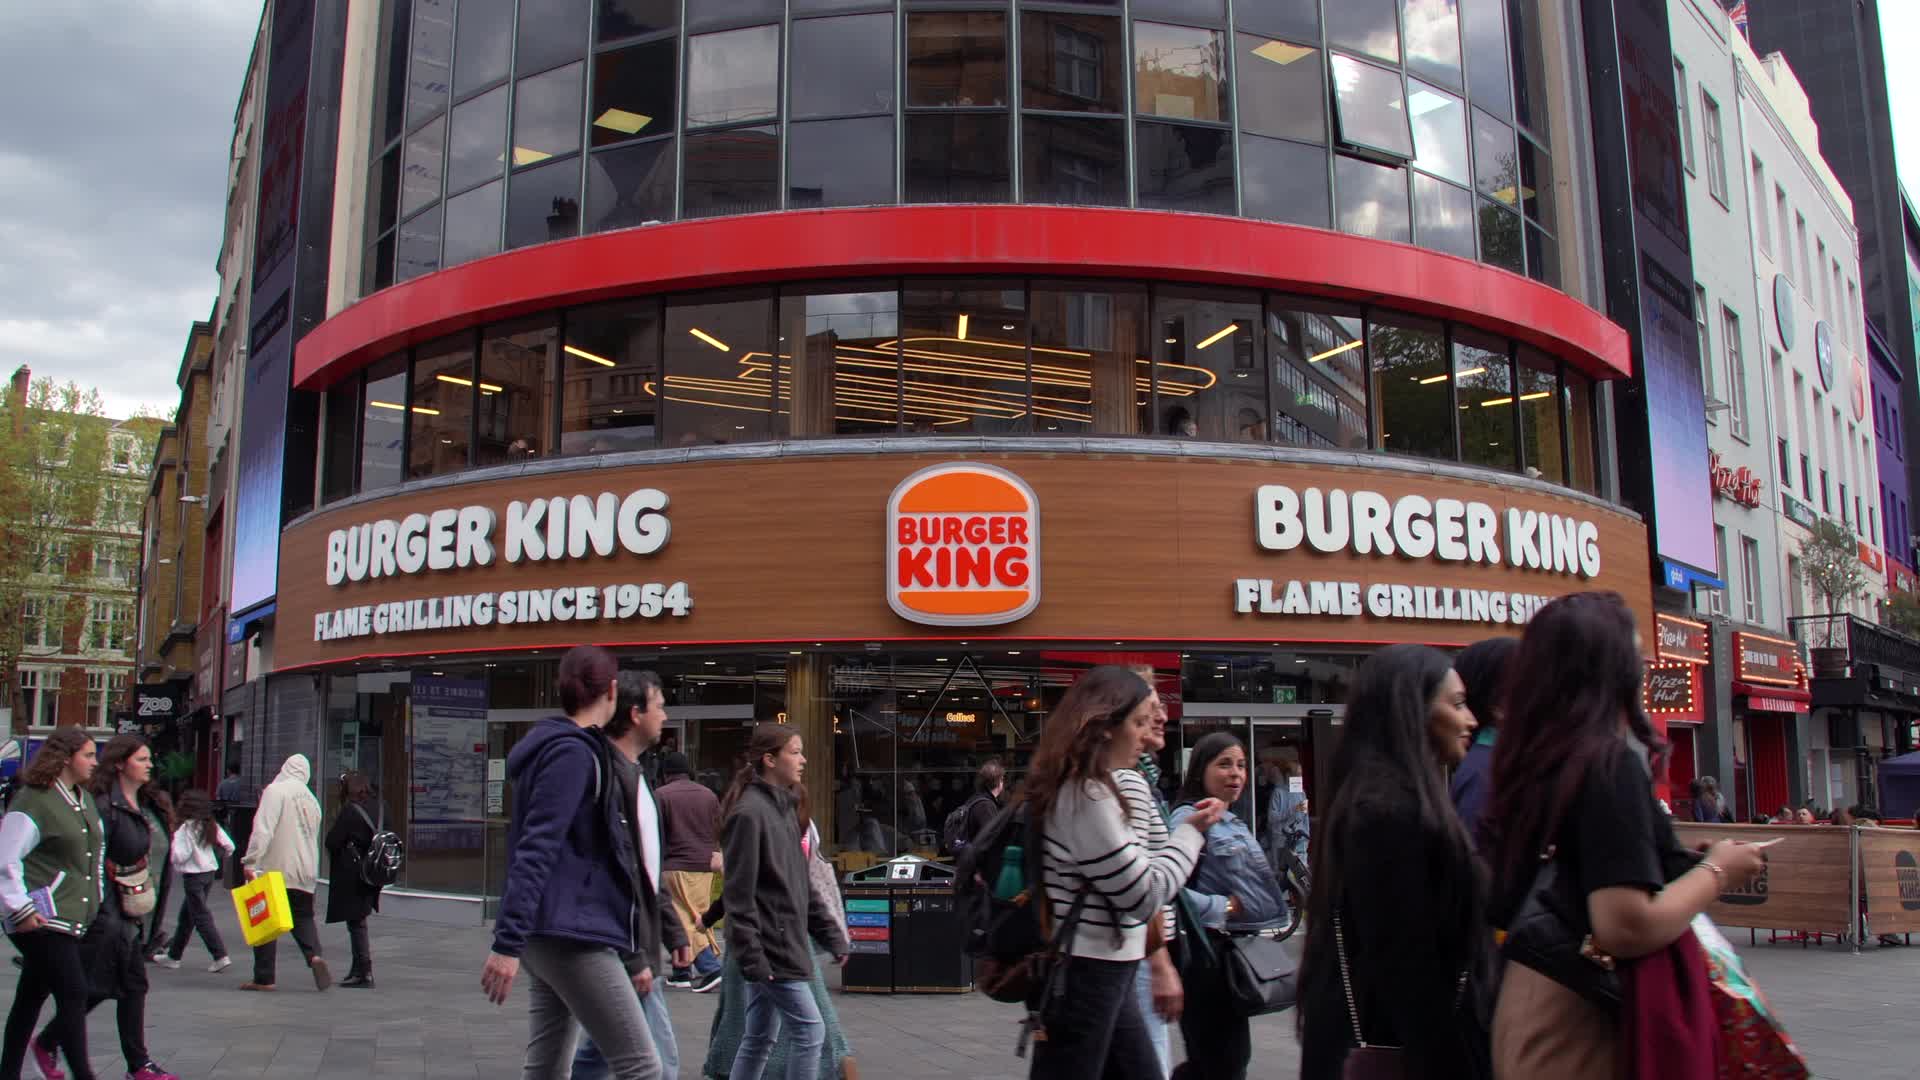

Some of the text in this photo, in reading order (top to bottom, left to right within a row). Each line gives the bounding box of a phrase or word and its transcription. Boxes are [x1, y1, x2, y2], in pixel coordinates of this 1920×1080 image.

[326, 488, 672, 586] BURGER KING
[897, 516, 1029, 545] BURGER
[1256, 484, 1601, 578] BURGER KING
[898, 546, 1029, 588] KING
[314, 581, 693, 642] FLAME GRILLING SINCE 1954
[1235, 578, 1363, 616] FLAME
[1367, 583, 1508, 624] GRILLING
[1649, 675, 1686, 689] Pizza
[1653, 689, 1680, 702] Hut
[946, 713, 976, 723] Collect
